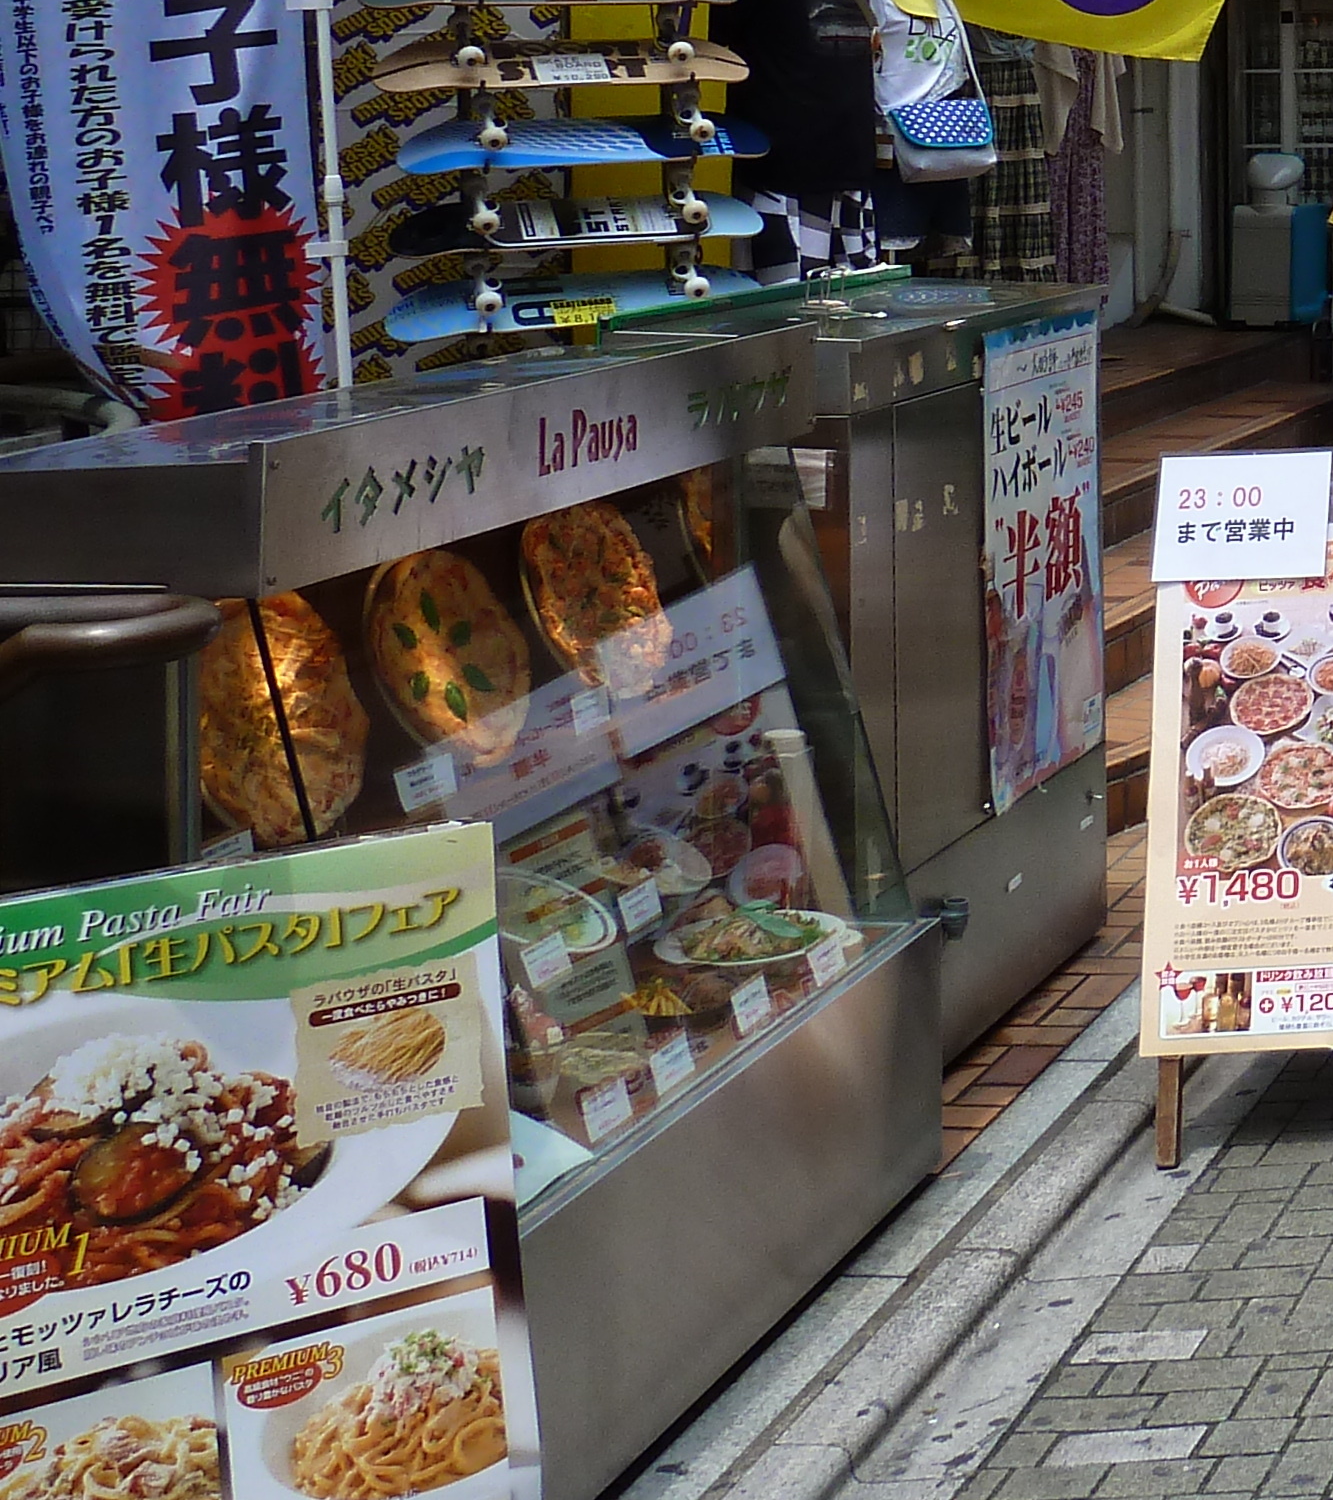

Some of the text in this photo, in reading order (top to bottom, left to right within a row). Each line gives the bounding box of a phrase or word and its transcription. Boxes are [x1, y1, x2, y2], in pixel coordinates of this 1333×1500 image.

[538, 408, 637, 477] La Pausa
[990, 394, 1053, 456] 生ビール
[992, 438, 1068, 503] ハイボール
[1177, 518, 1295, 544] まで営業中
[78, 899, 181, 943] Pasta
[195, 883, 272, 922] Fair
[285, 1241, 403, 1307] ¥680
[231, 1341, 345, 1385] PREMIUM 3
